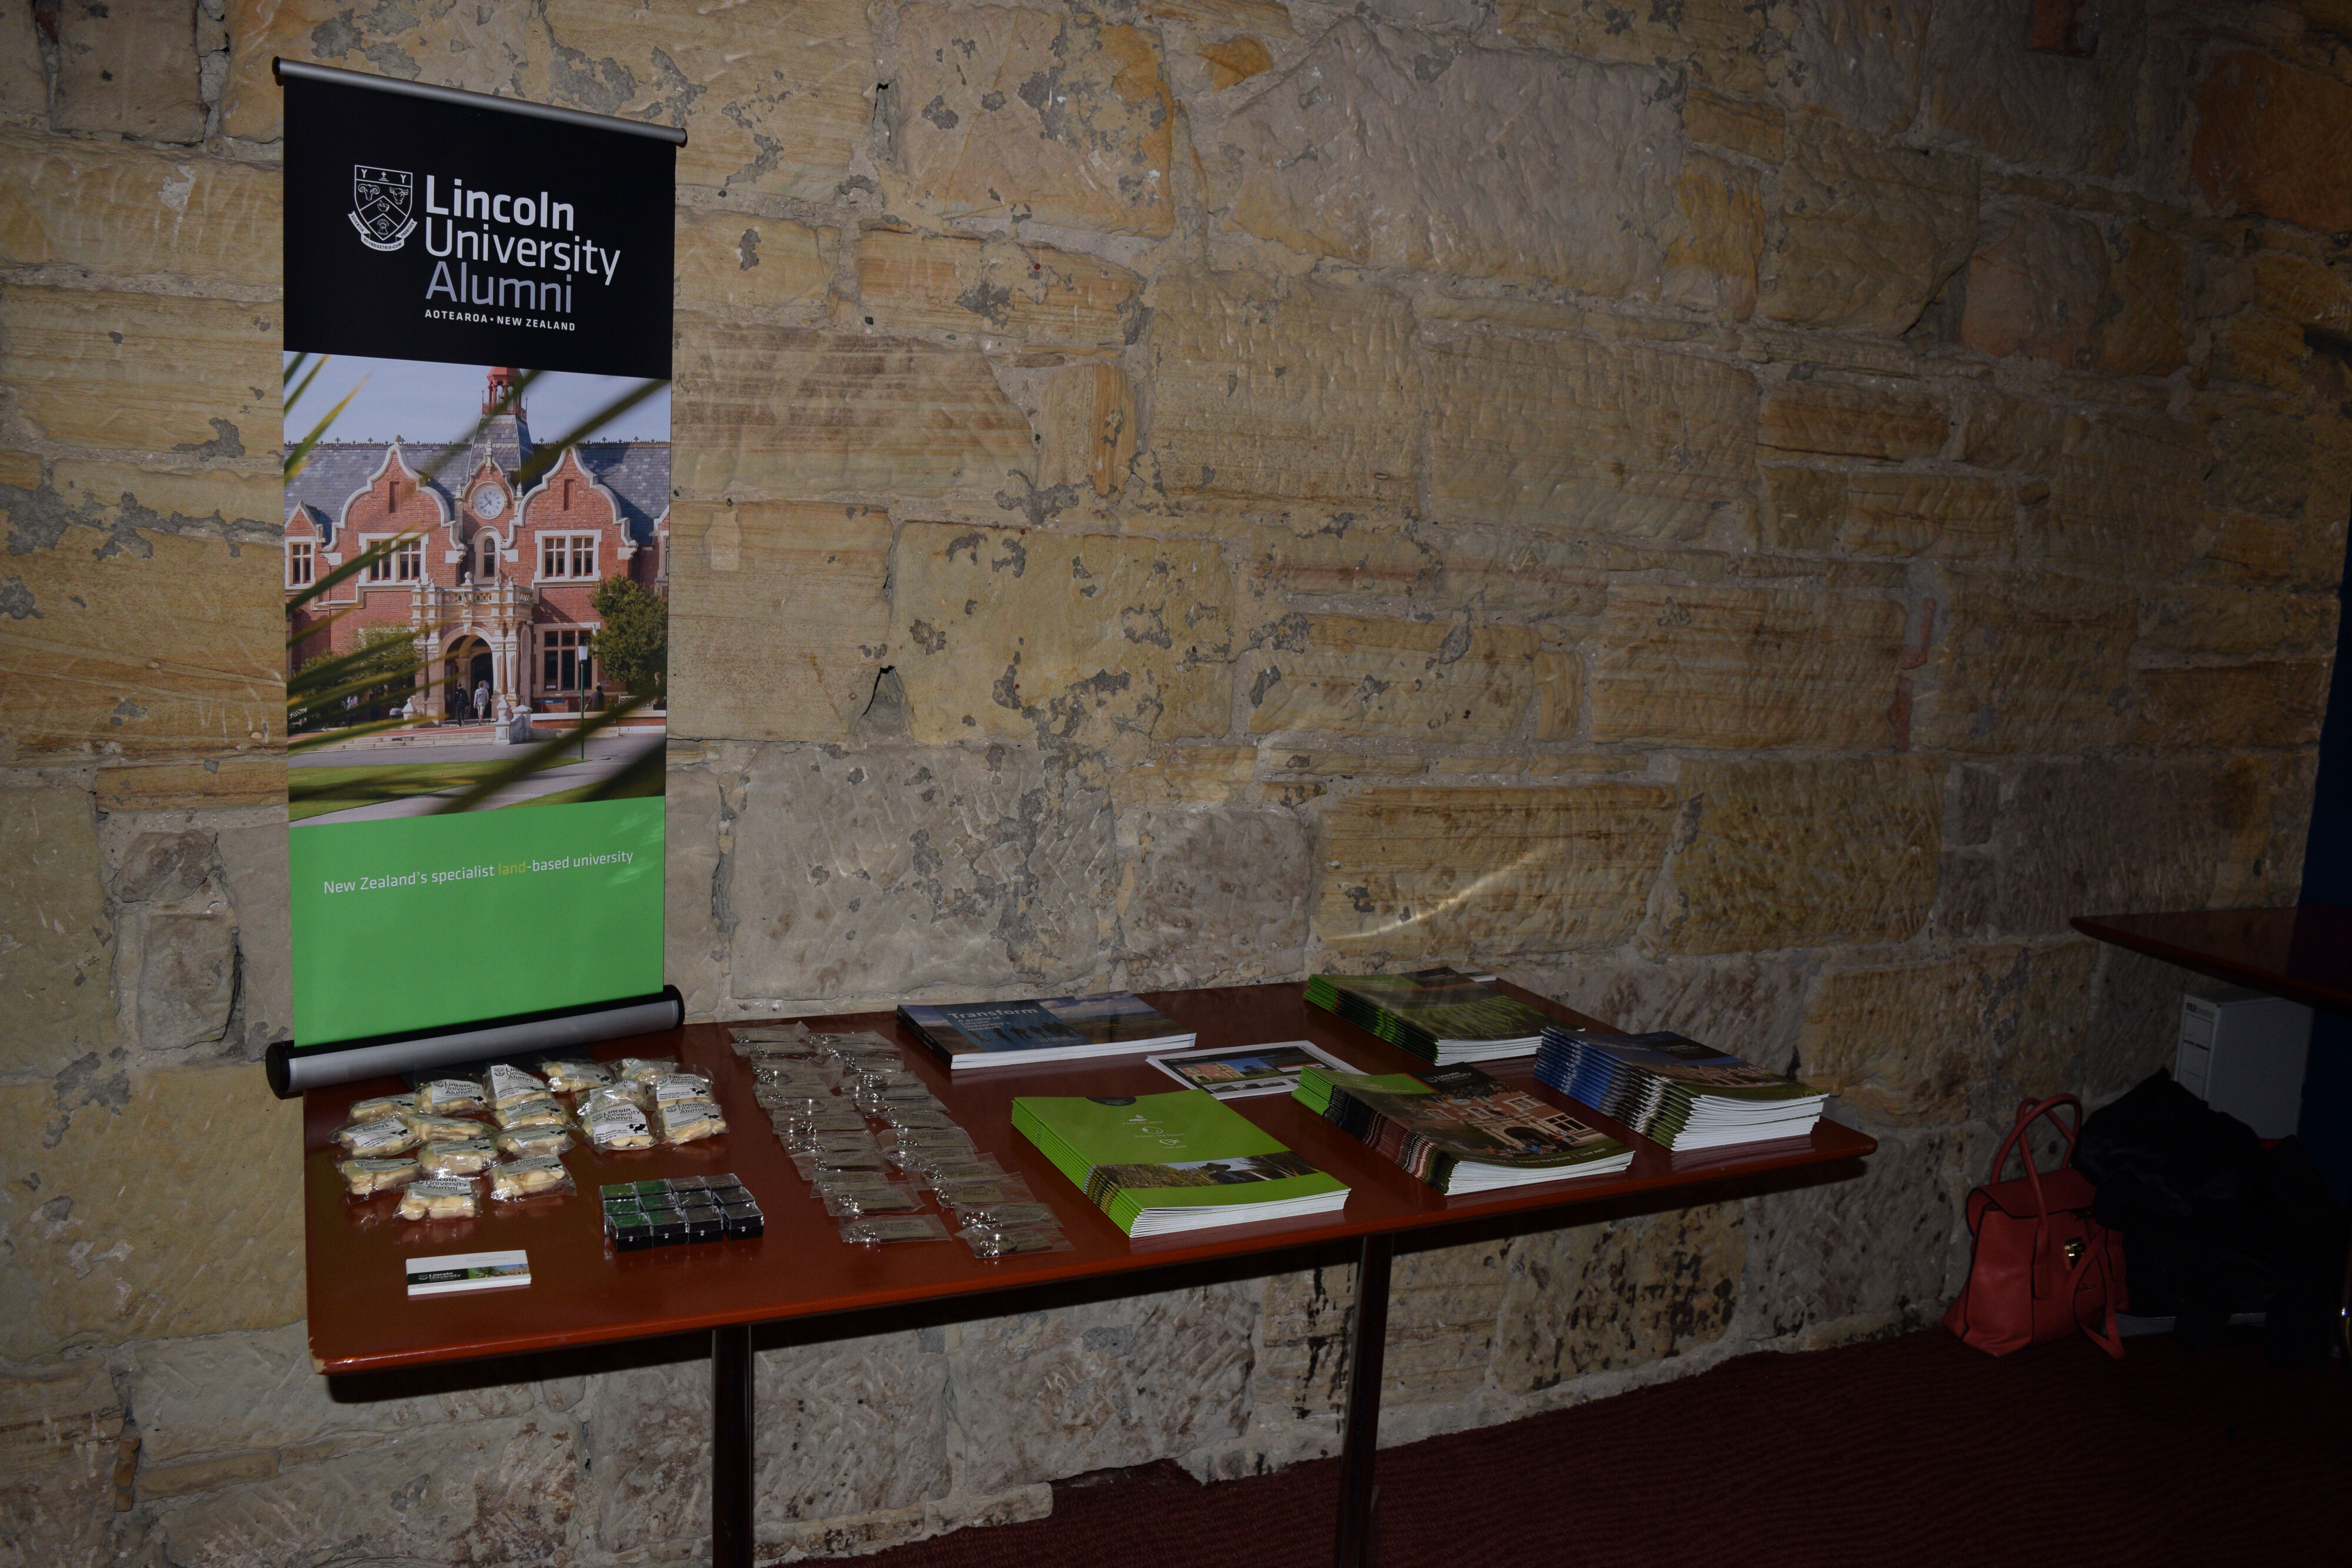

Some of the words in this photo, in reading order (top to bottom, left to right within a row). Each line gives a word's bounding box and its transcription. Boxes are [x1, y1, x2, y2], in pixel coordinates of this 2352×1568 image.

[426, 174, 574, 231] Lincoln
[351, 215, 365, 232] SCIENTIA
[425, 216, 621, 286] University
[425, 261, 572, 313] Alumni
[425, 309, 488, 323] AOTEAROA
[496, 315, 522, 326] NEW
[525, 318, 576, 332] ZEALAND
[323, 881, 356, 894] New
[359, 871, 428, 890] Zealand's
[432, 864, 495, 885] specialist
[498, 856, 569, 876] land-based
[573, 850, 634, 868] university
[948, 1009, 1039, 1019] Transform
[604, 1110, 640, 1119] University
